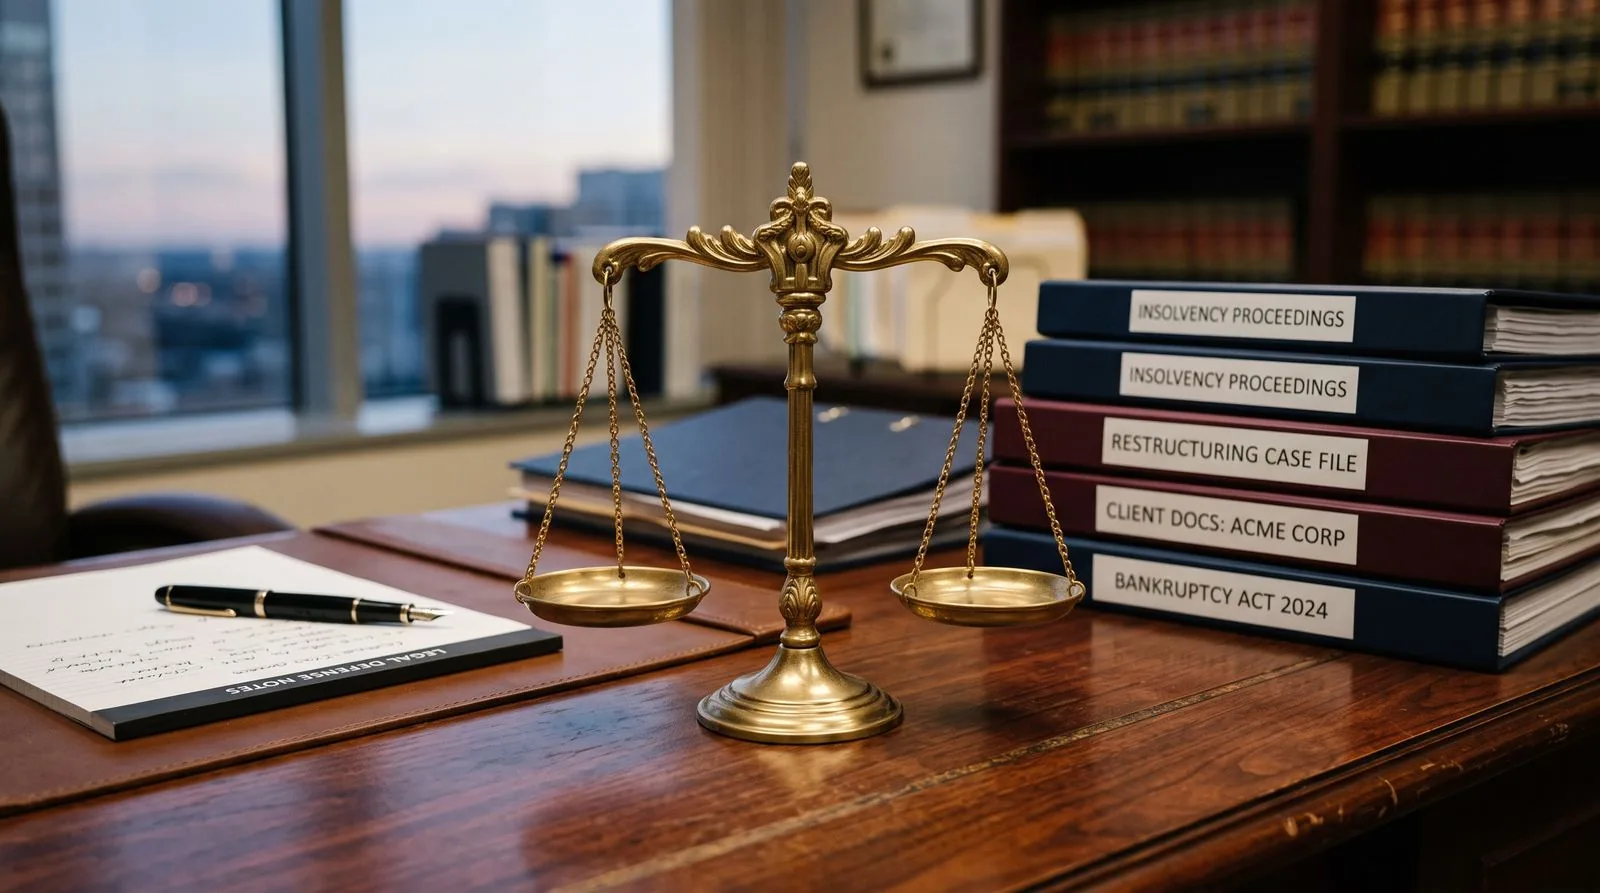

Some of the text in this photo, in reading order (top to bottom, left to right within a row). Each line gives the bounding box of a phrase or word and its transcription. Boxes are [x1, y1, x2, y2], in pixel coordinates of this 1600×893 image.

[1138, 304, 1345, 328] INSOLVENCY PROCEEDINGS
[1129, 367, 1348, 399] INSOLVENCY PROCEEDINGS
[1111, 433, 1358, 473] RESTRUCTURING CASE FILE
[1106, 501, 1346, 548] CLIENT DOCS: ACME CORP
[1114, 571, 1329, 620] BANKRUPTCY ACT 2024
[225, 648, 448, 695] LEGAL DEFENSE NOTES
